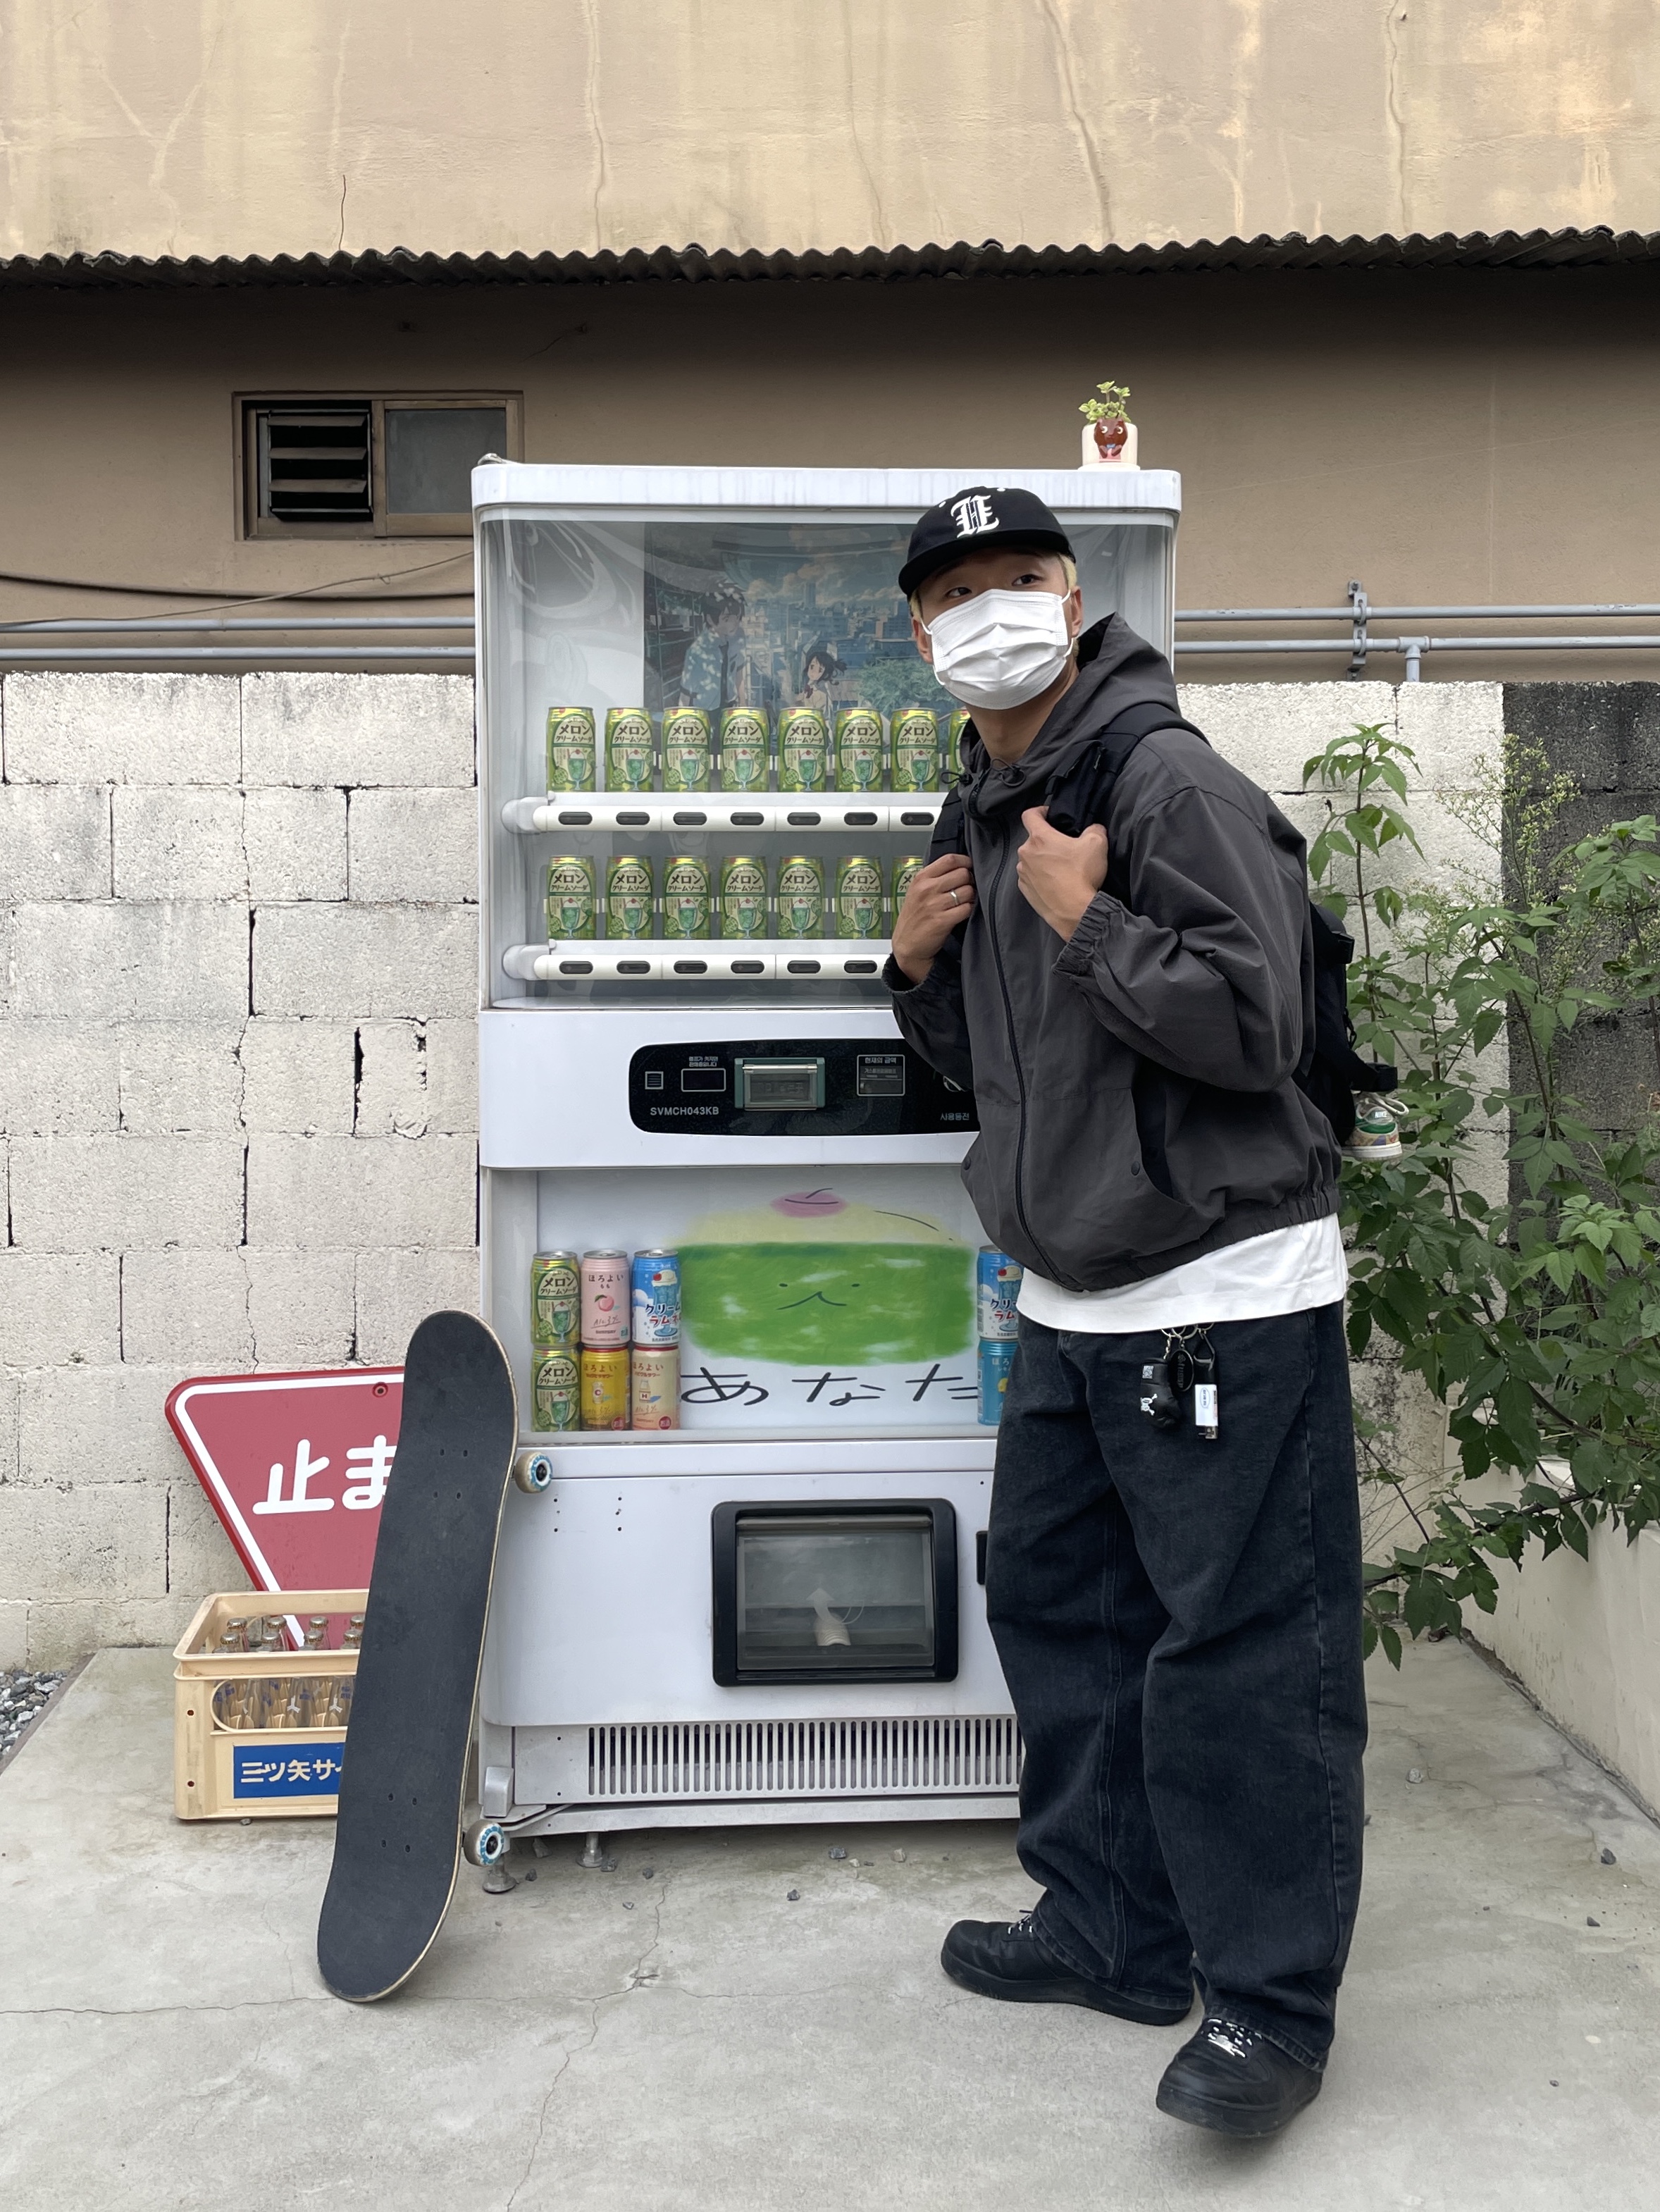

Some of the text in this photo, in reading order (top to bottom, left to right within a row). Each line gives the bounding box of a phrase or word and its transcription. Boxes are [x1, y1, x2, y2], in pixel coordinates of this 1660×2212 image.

[561, 724, 593, 736] メロン
[617, 725, 650, 736] メロン
[671, 725, 705, 736] メロン
[728, 725, 760, 736] メロン
[790, 726, 822, 736] メロン
[846, 726, 879, 736] メロン
[903, 726, 934, 736] メロン
[553, 873, 586, 884] メロン
[616, 874, 649, 884] メロン
[671, 874, 703, 884] メロン
[729, 874, 762, 884] メロン
[784, 875, 817, 885] メロン
[846, 875, 879, 885] メロン
[650, 1106, 719, 1116] SVMCH043KB
[940, 1112, 970, 1121] 사용동전
[543, 1276, 575, 1287] メロン
[542, 1366, 575, 1377] メロン
[681, 1364, 979, 1407] あなた
[252, 1435, 397, 1515] 止ま
